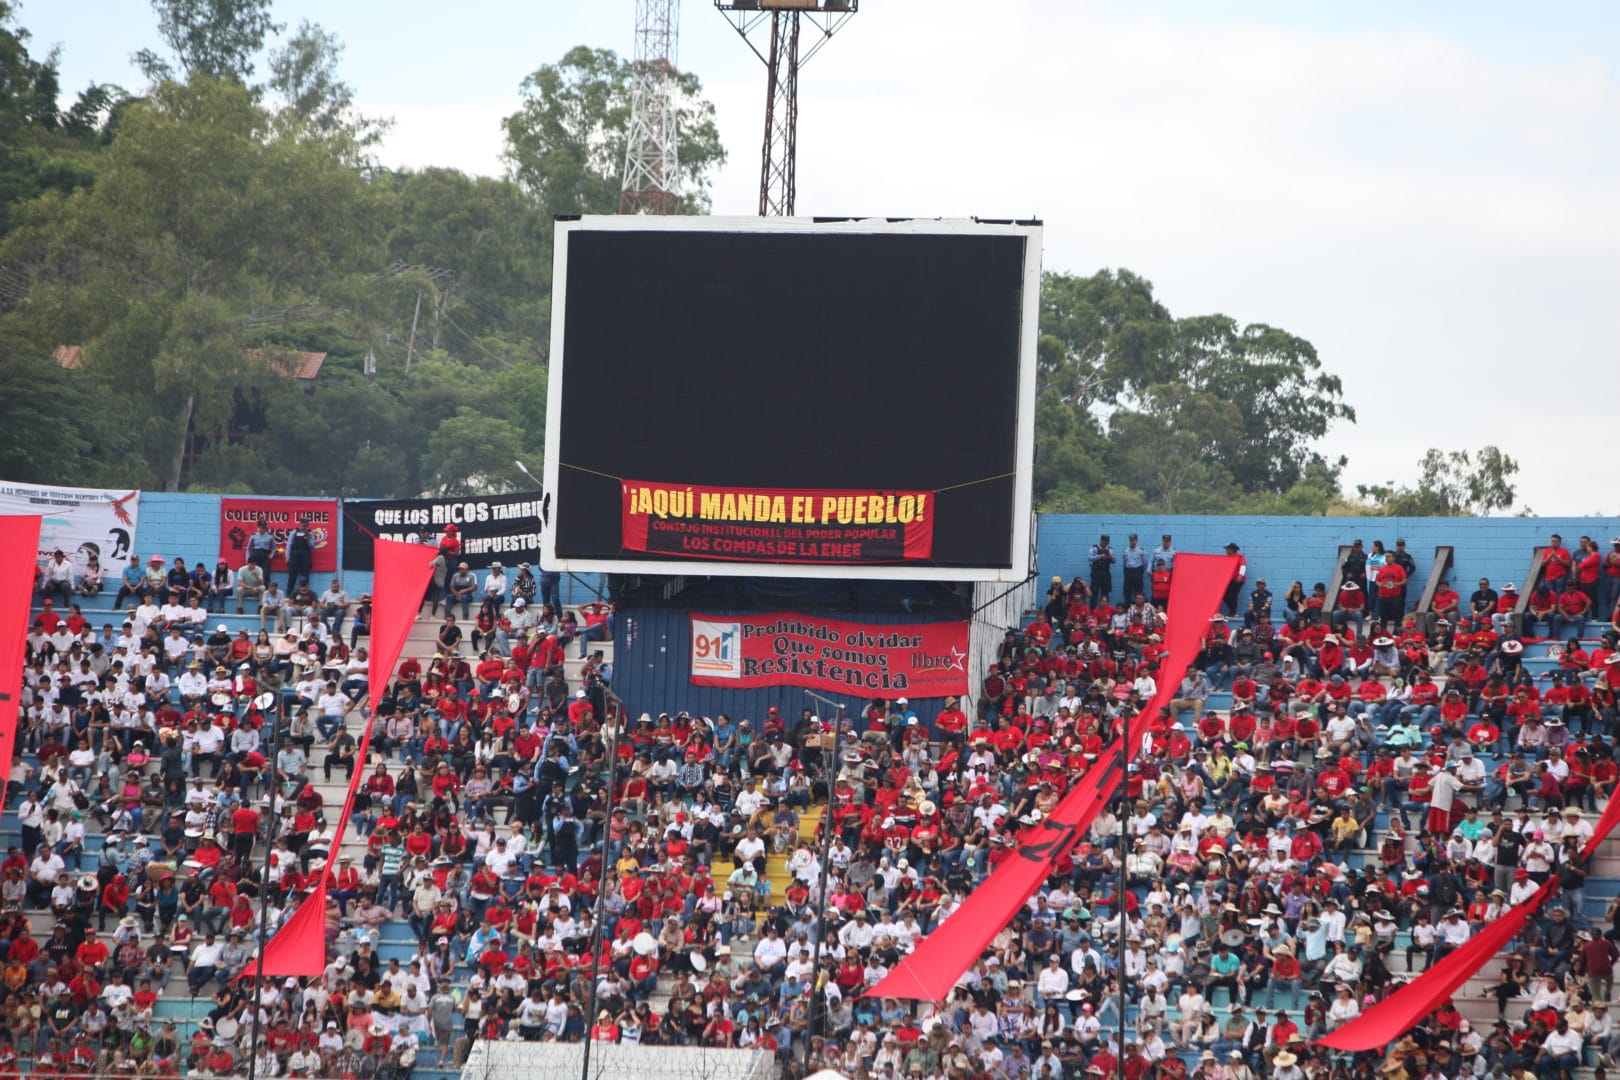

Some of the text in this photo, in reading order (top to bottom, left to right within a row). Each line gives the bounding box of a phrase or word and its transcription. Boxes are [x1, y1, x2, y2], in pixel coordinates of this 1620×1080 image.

[225, 509, 329, 524] COLECTIVO LIBRE
[375, 509, 401, 526] QUE
[403, 509, 430, 525] LOS
[432, 502, 489, 524] RICOS
[630, 487, 926, 525] ¡AQUÍ MANDA EL PUEBLO!
[652, 520, 897, 540] CONSEJO INSTITUCIONAL DEL PODER POPULAR
[682, 536, 862, 557] LOS COMPAS DE LA ENEE
[743, 619, 923, 649] Prohibido olvidar
[773, 636, 888, 667] Que somos
[911, 652, 952, 668] libre
[743, 652, 910, 690] Resistencia
